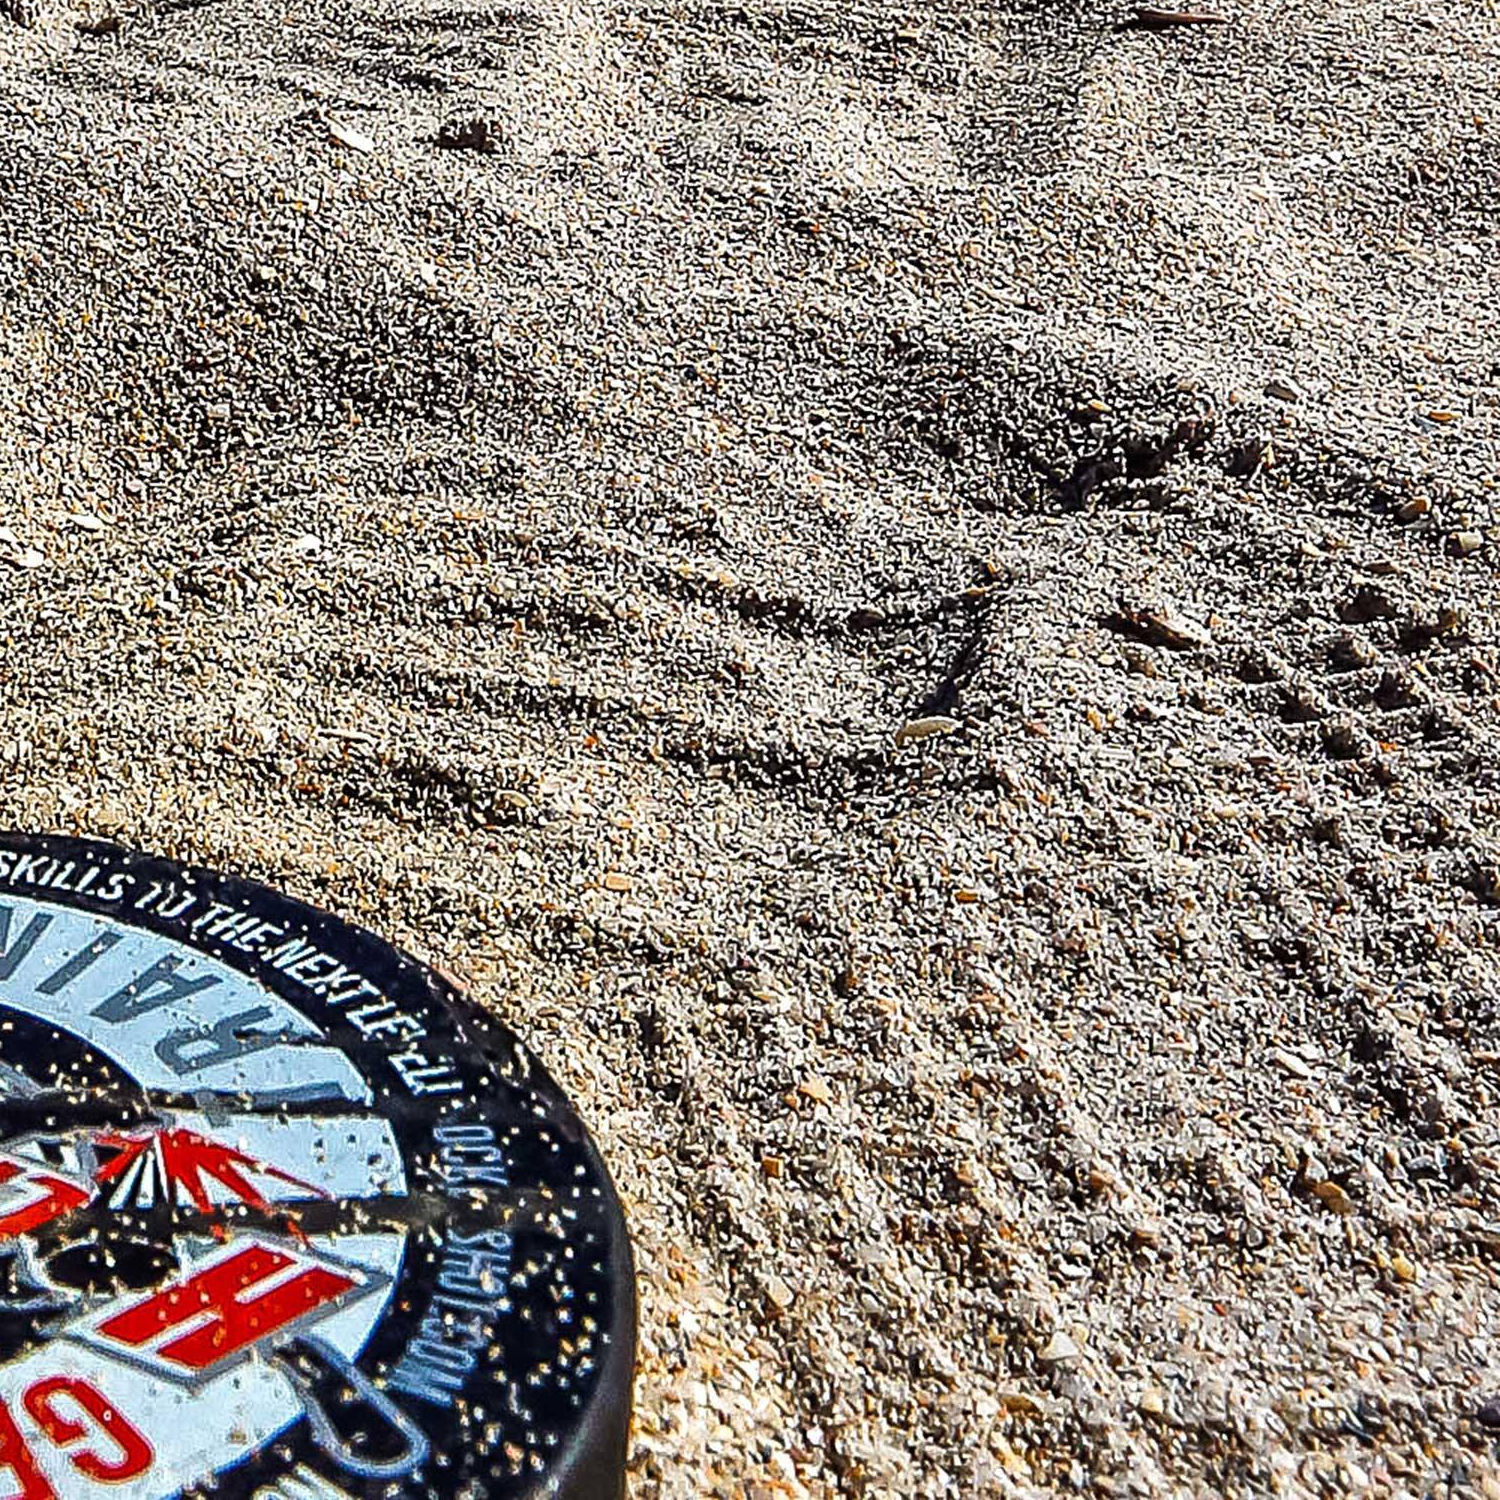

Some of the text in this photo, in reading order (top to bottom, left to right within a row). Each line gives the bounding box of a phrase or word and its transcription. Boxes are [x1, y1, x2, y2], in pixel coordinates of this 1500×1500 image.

[132, 881, 196, 919] TO
[193, 901, 285, 953] THE
[262, 937, 380, 1007] NEXT
